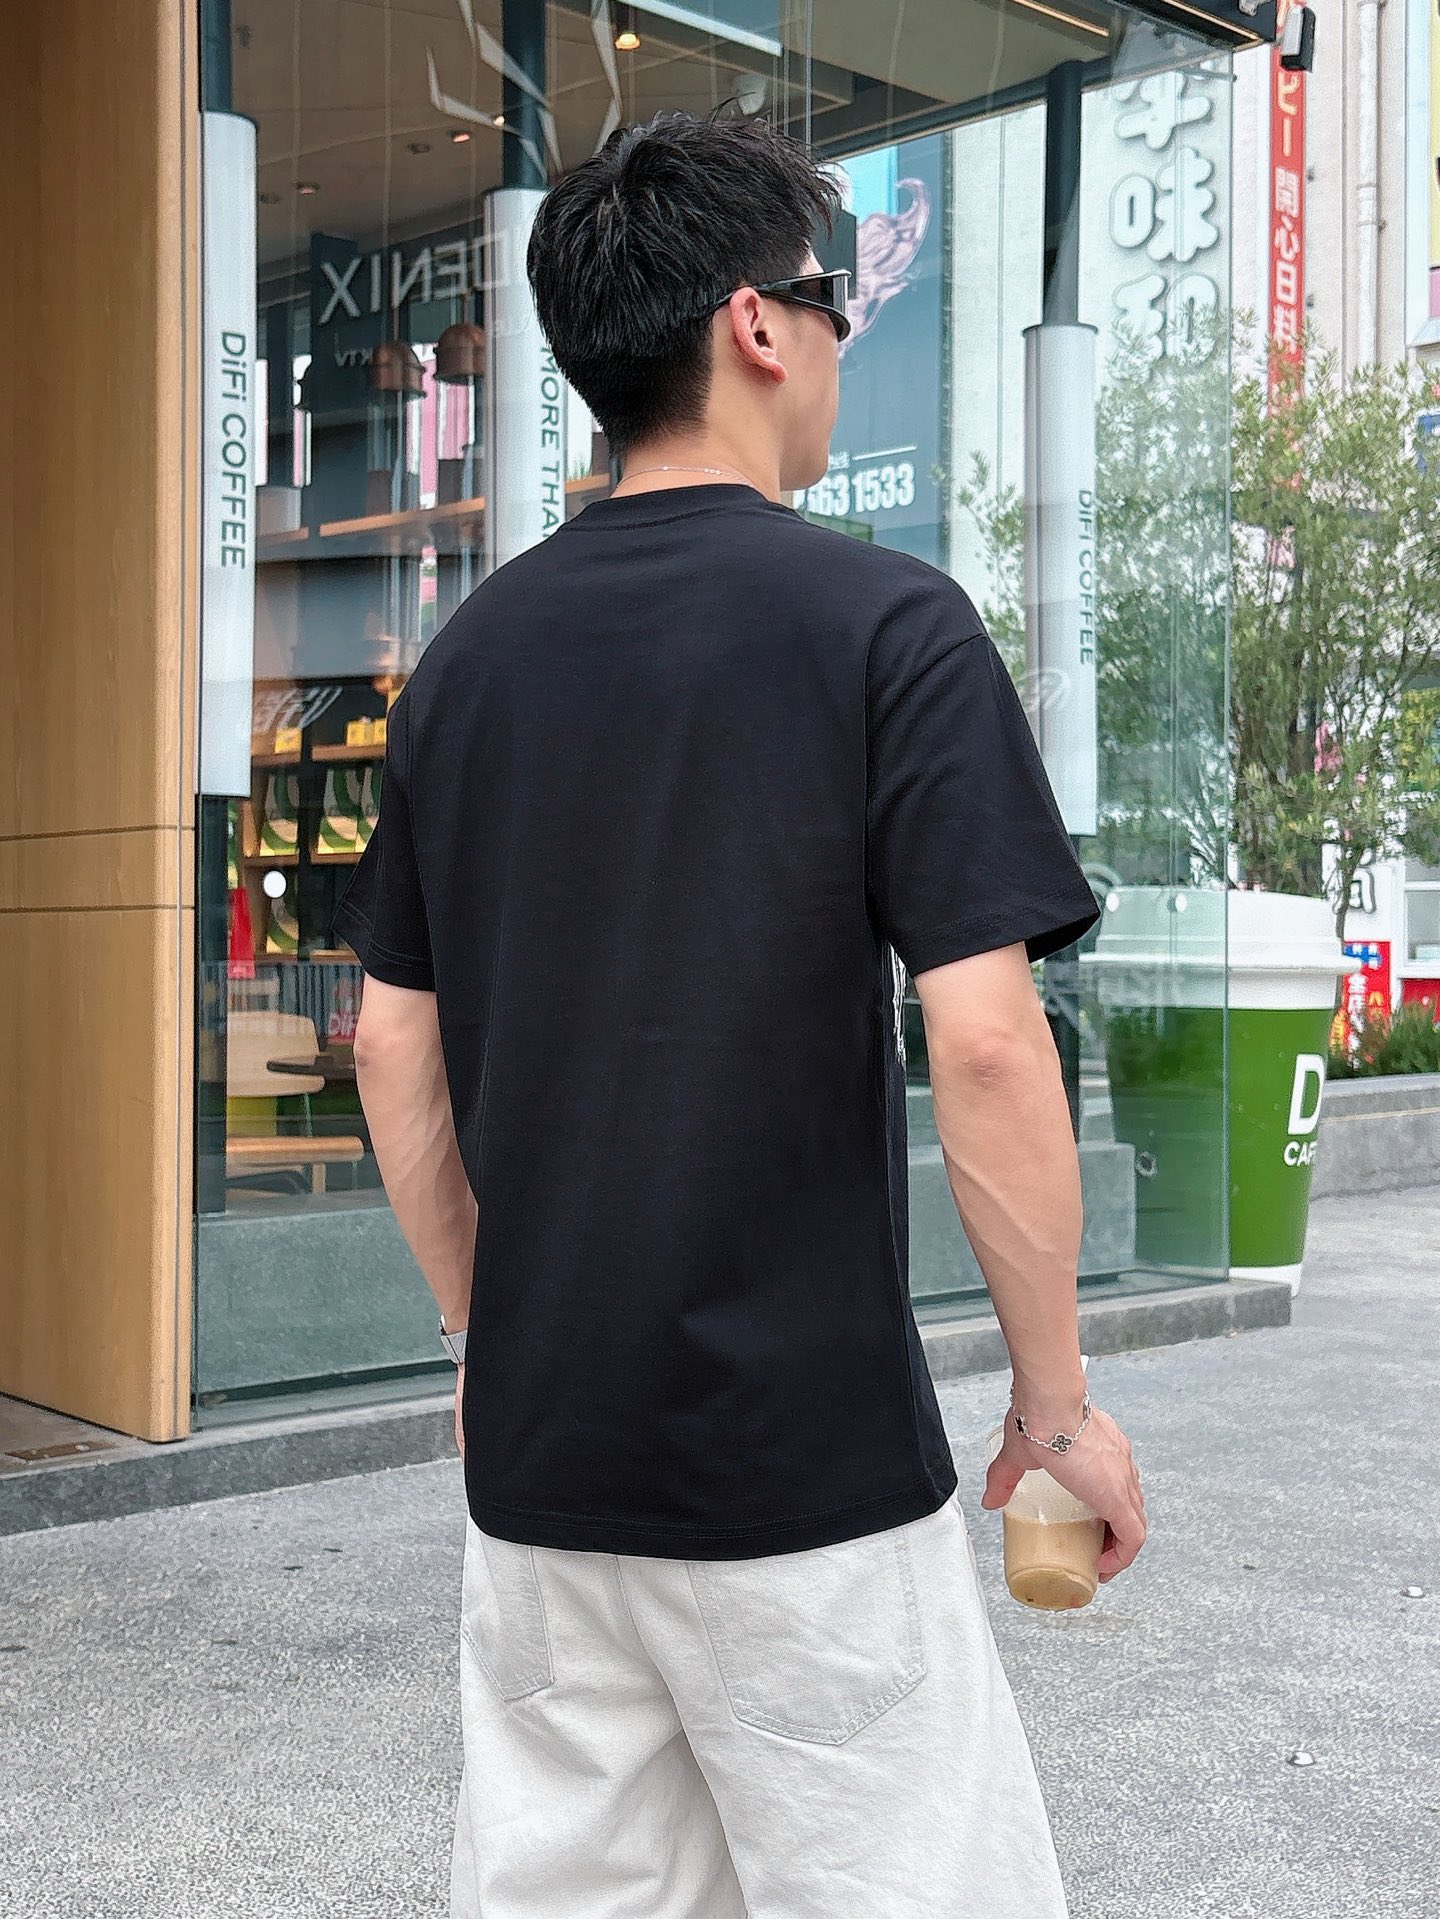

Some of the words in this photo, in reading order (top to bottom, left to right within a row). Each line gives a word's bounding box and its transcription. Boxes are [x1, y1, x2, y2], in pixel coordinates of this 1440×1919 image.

[541, 346, 560, 450] MORE
[221, 413, 247, 569] COFFEE
[541, 465, 560, 537] THA
[852, 463, 915, 513] 1533
[1078, 549, 1093, 665] COFFEE
[1288, 1053, 1325, 1135] D
